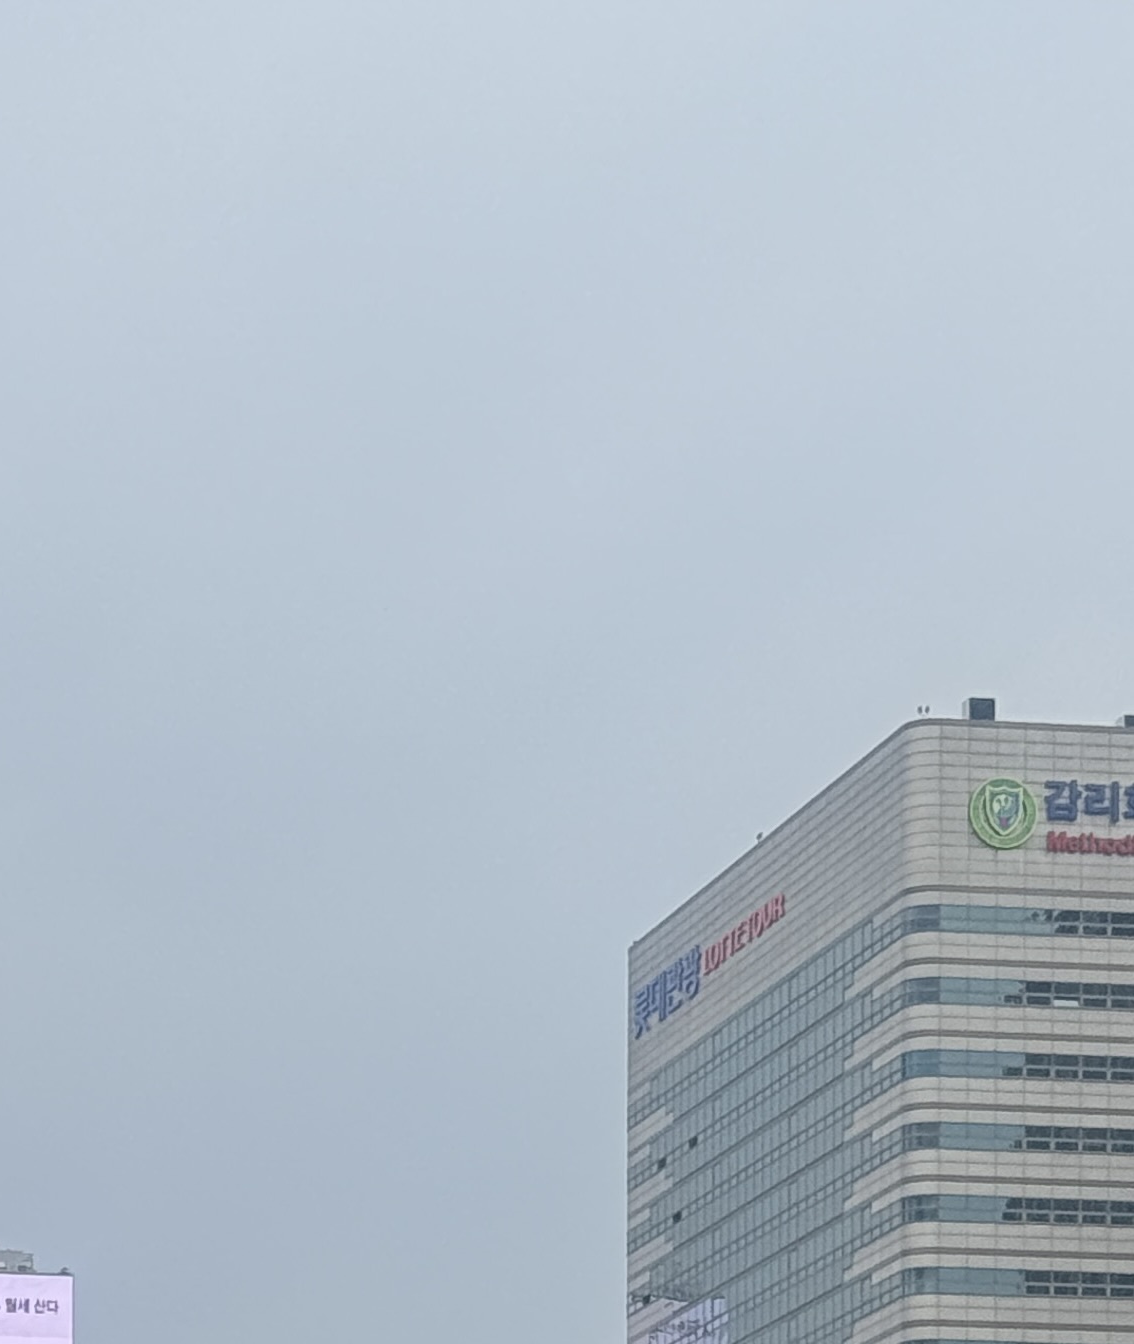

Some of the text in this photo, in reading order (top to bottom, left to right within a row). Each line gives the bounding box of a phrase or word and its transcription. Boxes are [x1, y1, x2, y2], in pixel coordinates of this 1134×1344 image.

[1044, 780, 1134, 824] 감리
[5, 1298, 30, 1314] 월세
[34, 1298, 59, 1314] 산다
